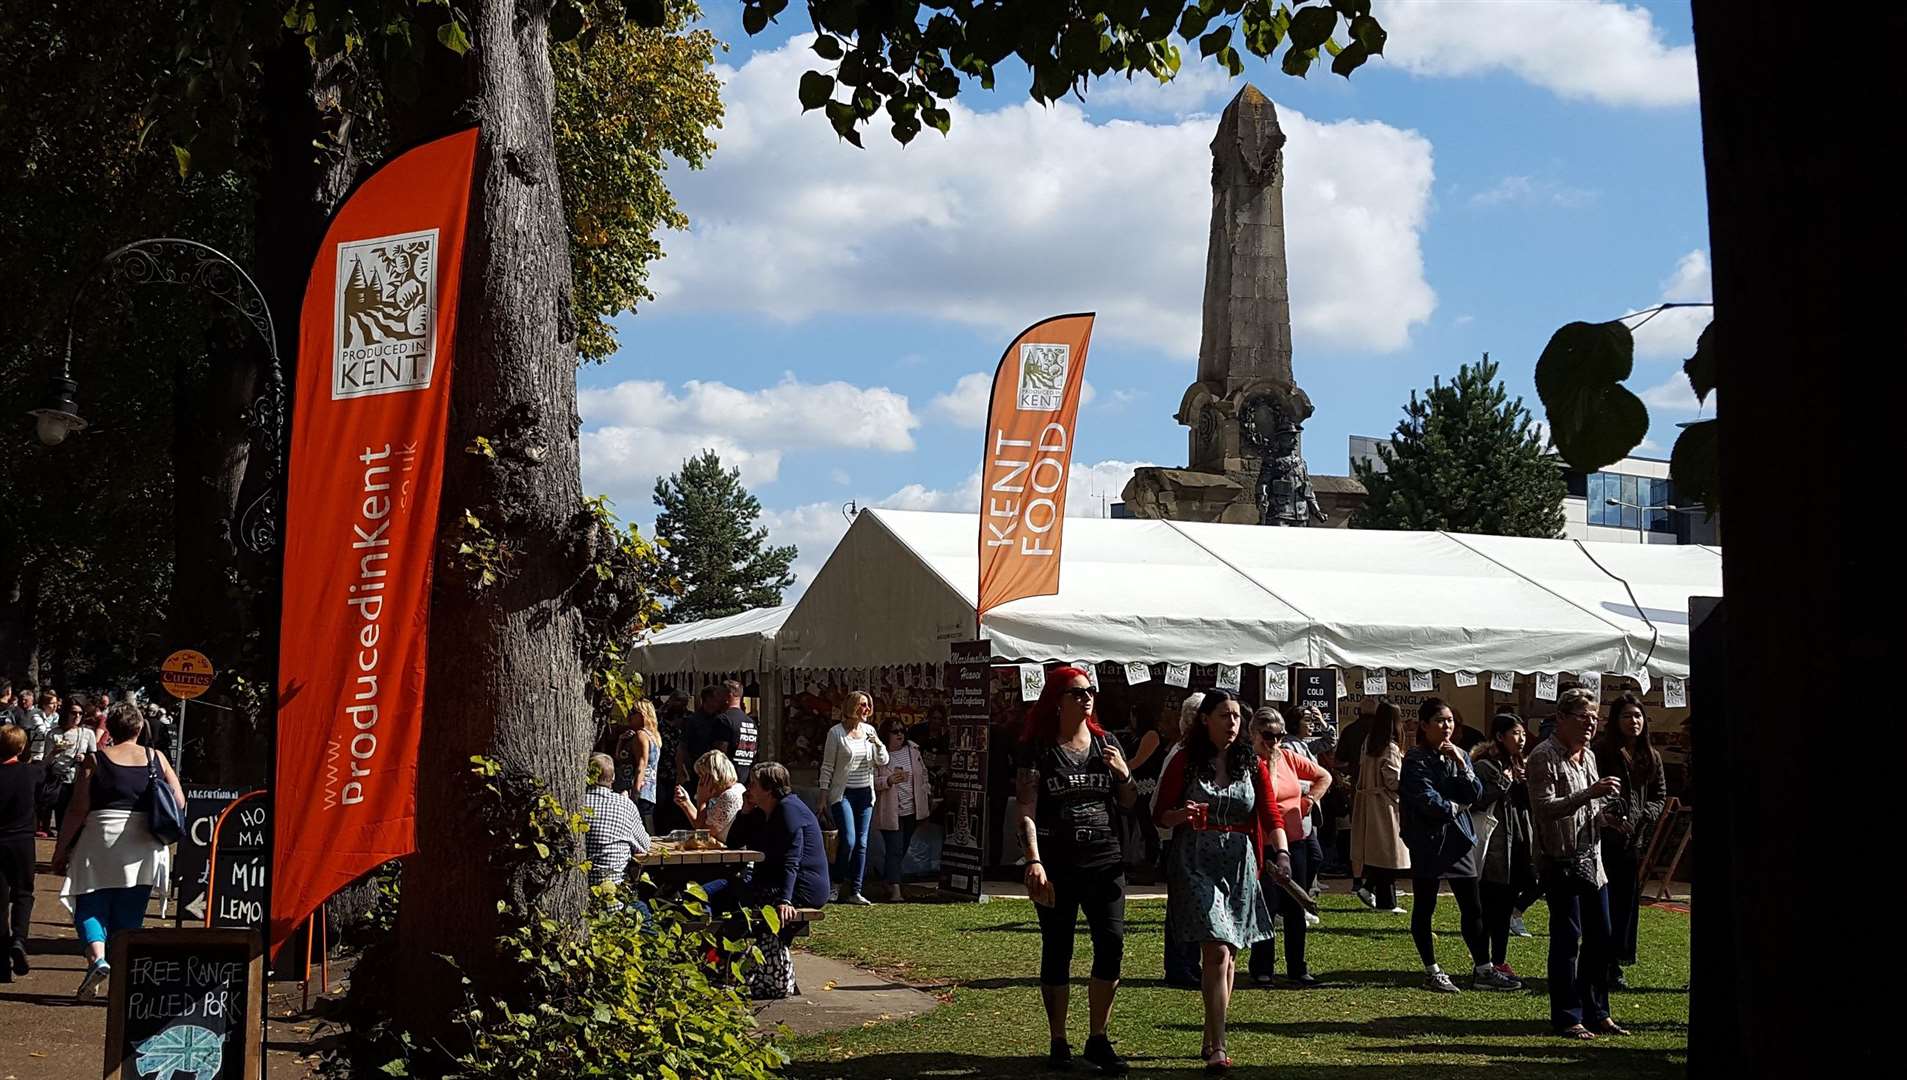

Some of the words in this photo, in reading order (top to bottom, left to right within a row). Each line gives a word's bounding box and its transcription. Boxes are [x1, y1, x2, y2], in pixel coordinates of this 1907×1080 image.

[342, 343, 408, 361] PRODUCED
[411, 340, 426, 353] IN
[341, 353, 426, 389] KENT
[1021, 394, 1062, 407] KENT
[987, 429, 1032, 547] KENT
[1020, 422, 1067, 556] FOOD
[342, 443, 391, 805] producedinKent
[163, 671, 210, 685] Curries
[1306, 688, 1324, 696] COLD
[1310, 676, 1320, 685] ICE
[323, 735, 342, 810] www.
[240, 807, 266, 827] HO
[239, 831, 265, 847] MA
[219, 895, 264, 924] LEMO
[130, 956, 180, 985] FREE
[185, 955, 243, 988] RANGE
[128, 991, 200, 1019] PULLED
[202, 990, 241, 1023] PORK
